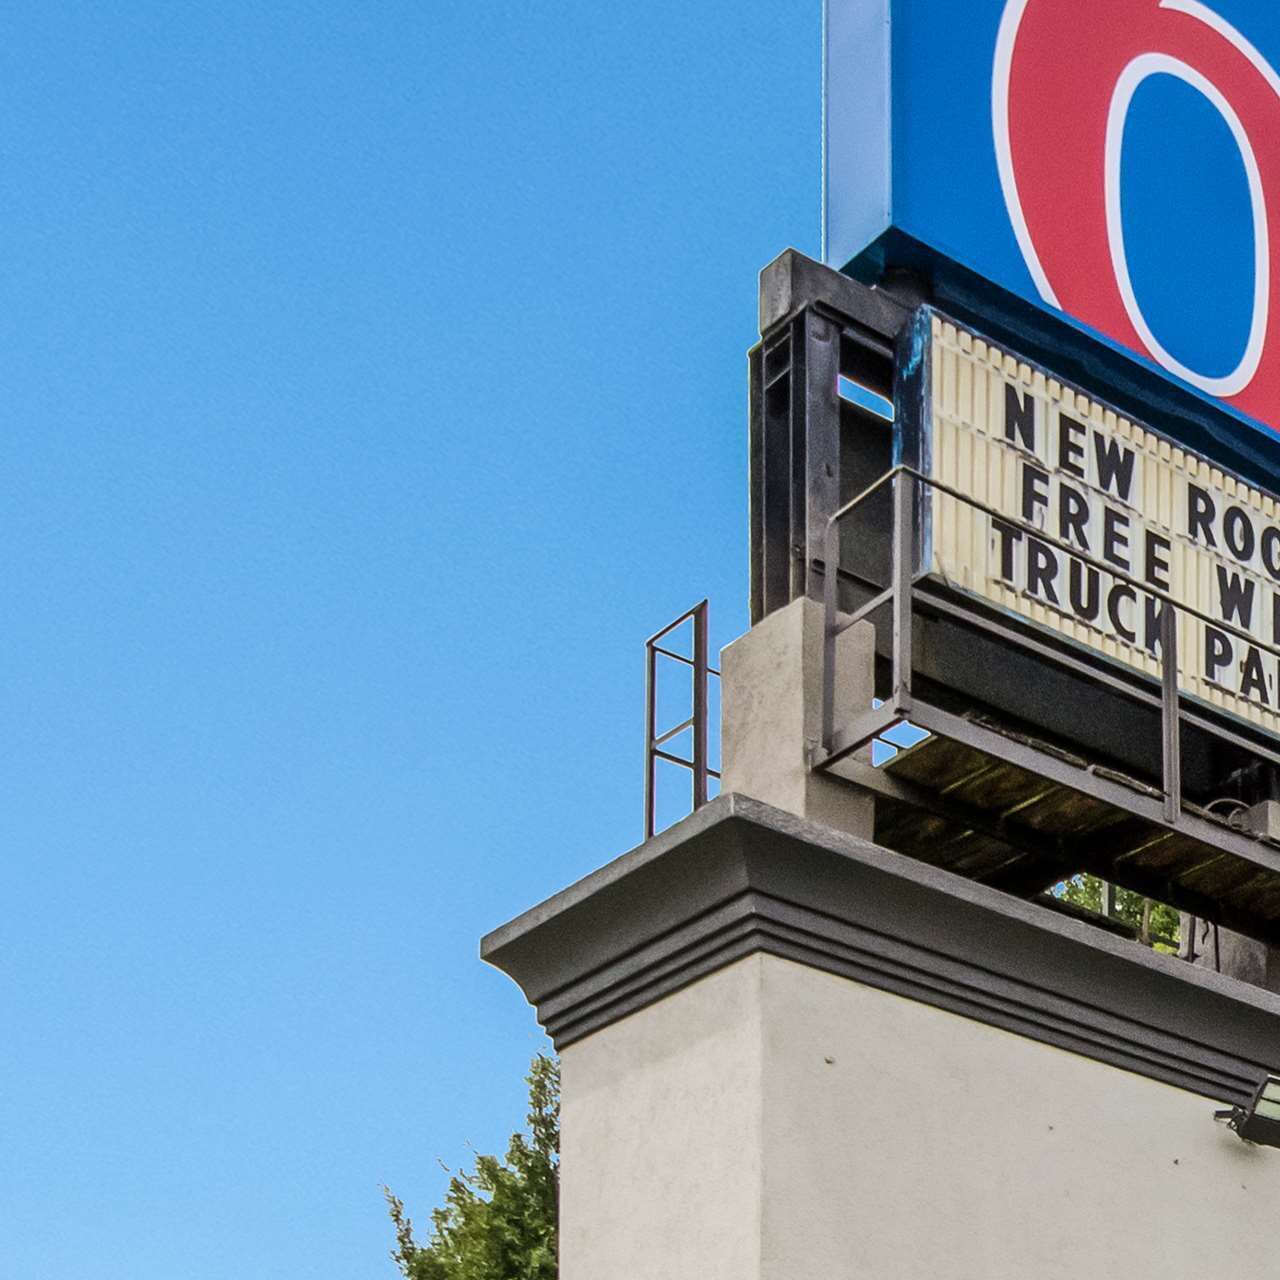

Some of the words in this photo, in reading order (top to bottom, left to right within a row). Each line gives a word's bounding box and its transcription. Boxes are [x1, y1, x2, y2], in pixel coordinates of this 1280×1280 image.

[1005, 383, 1135, 500] NEW
[991, 517, 1166, 656] TRUCK
[1022, 462, 1171, 593] FREE
